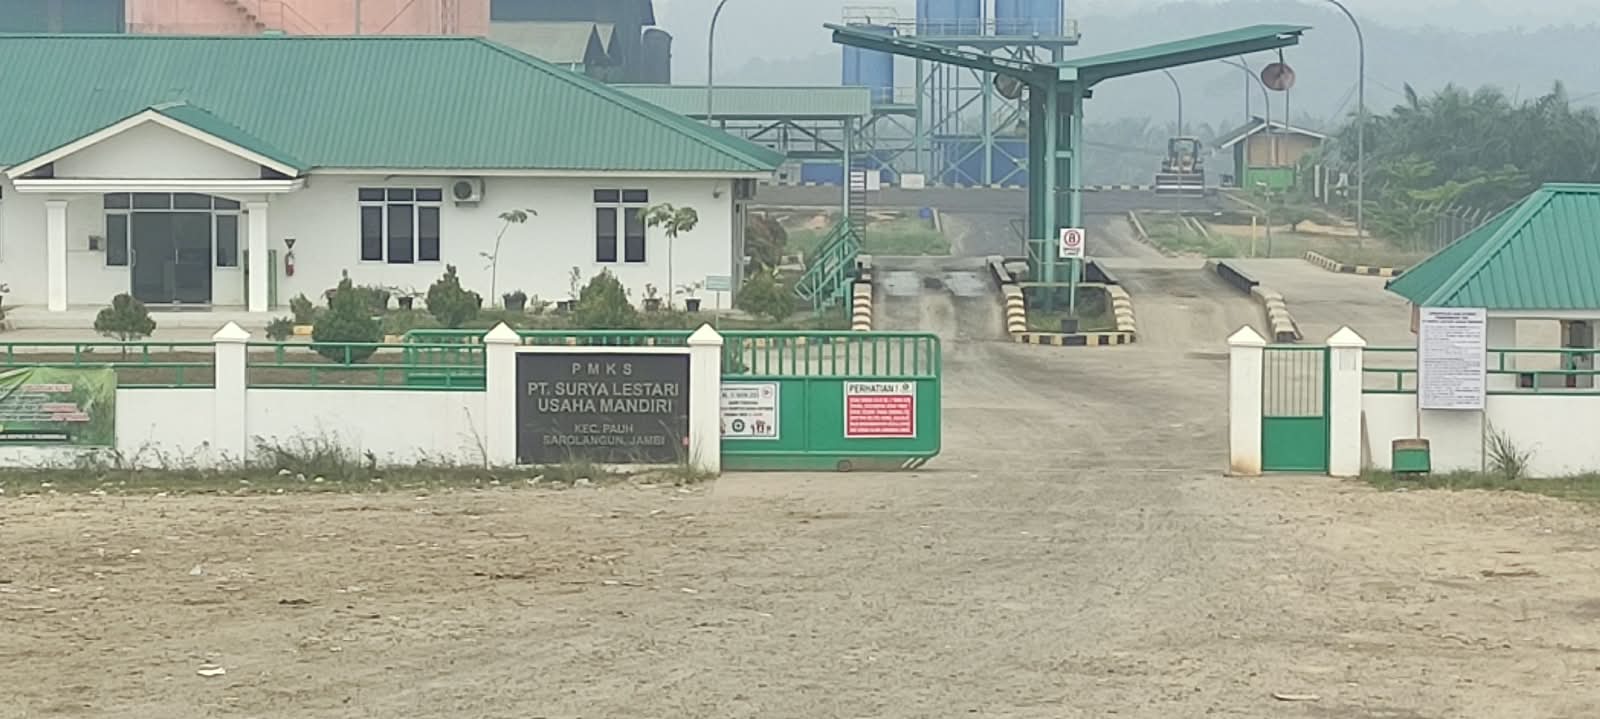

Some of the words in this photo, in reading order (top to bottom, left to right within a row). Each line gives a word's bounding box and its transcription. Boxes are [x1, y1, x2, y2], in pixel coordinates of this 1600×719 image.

[527, 382, 550, 396] PT.
[554, 382, 609, 396] SURYA
[612, 383, 679, 396] LESTARI
[538, 398, 596, 413] USAHA
[599, 399, 672, 413] MANDIRI
[602, 424, 634, 434] PAUH
[630, 435, 665, 446] JAMBI
